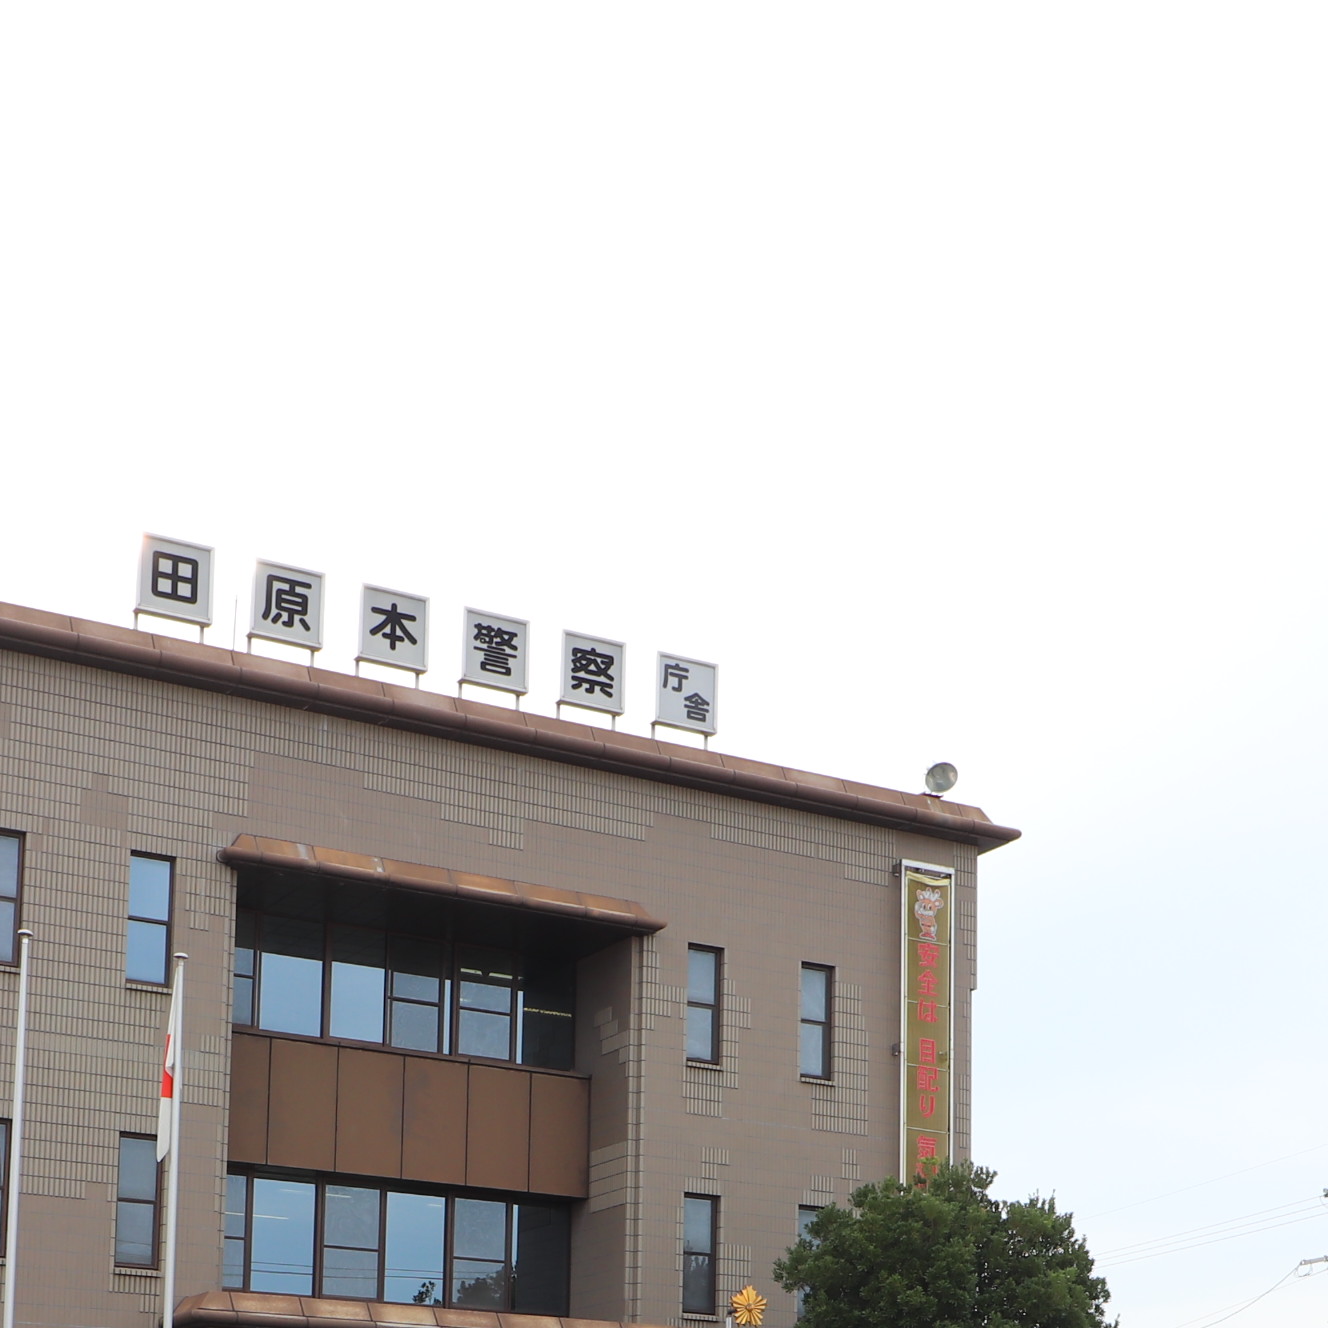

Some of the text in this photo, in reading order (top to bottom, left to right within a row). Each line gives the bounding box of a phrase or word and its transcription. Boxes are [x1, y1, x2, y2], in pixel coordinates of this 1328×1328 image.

[150, 549, 710, 723] 田原本警察庁舎
